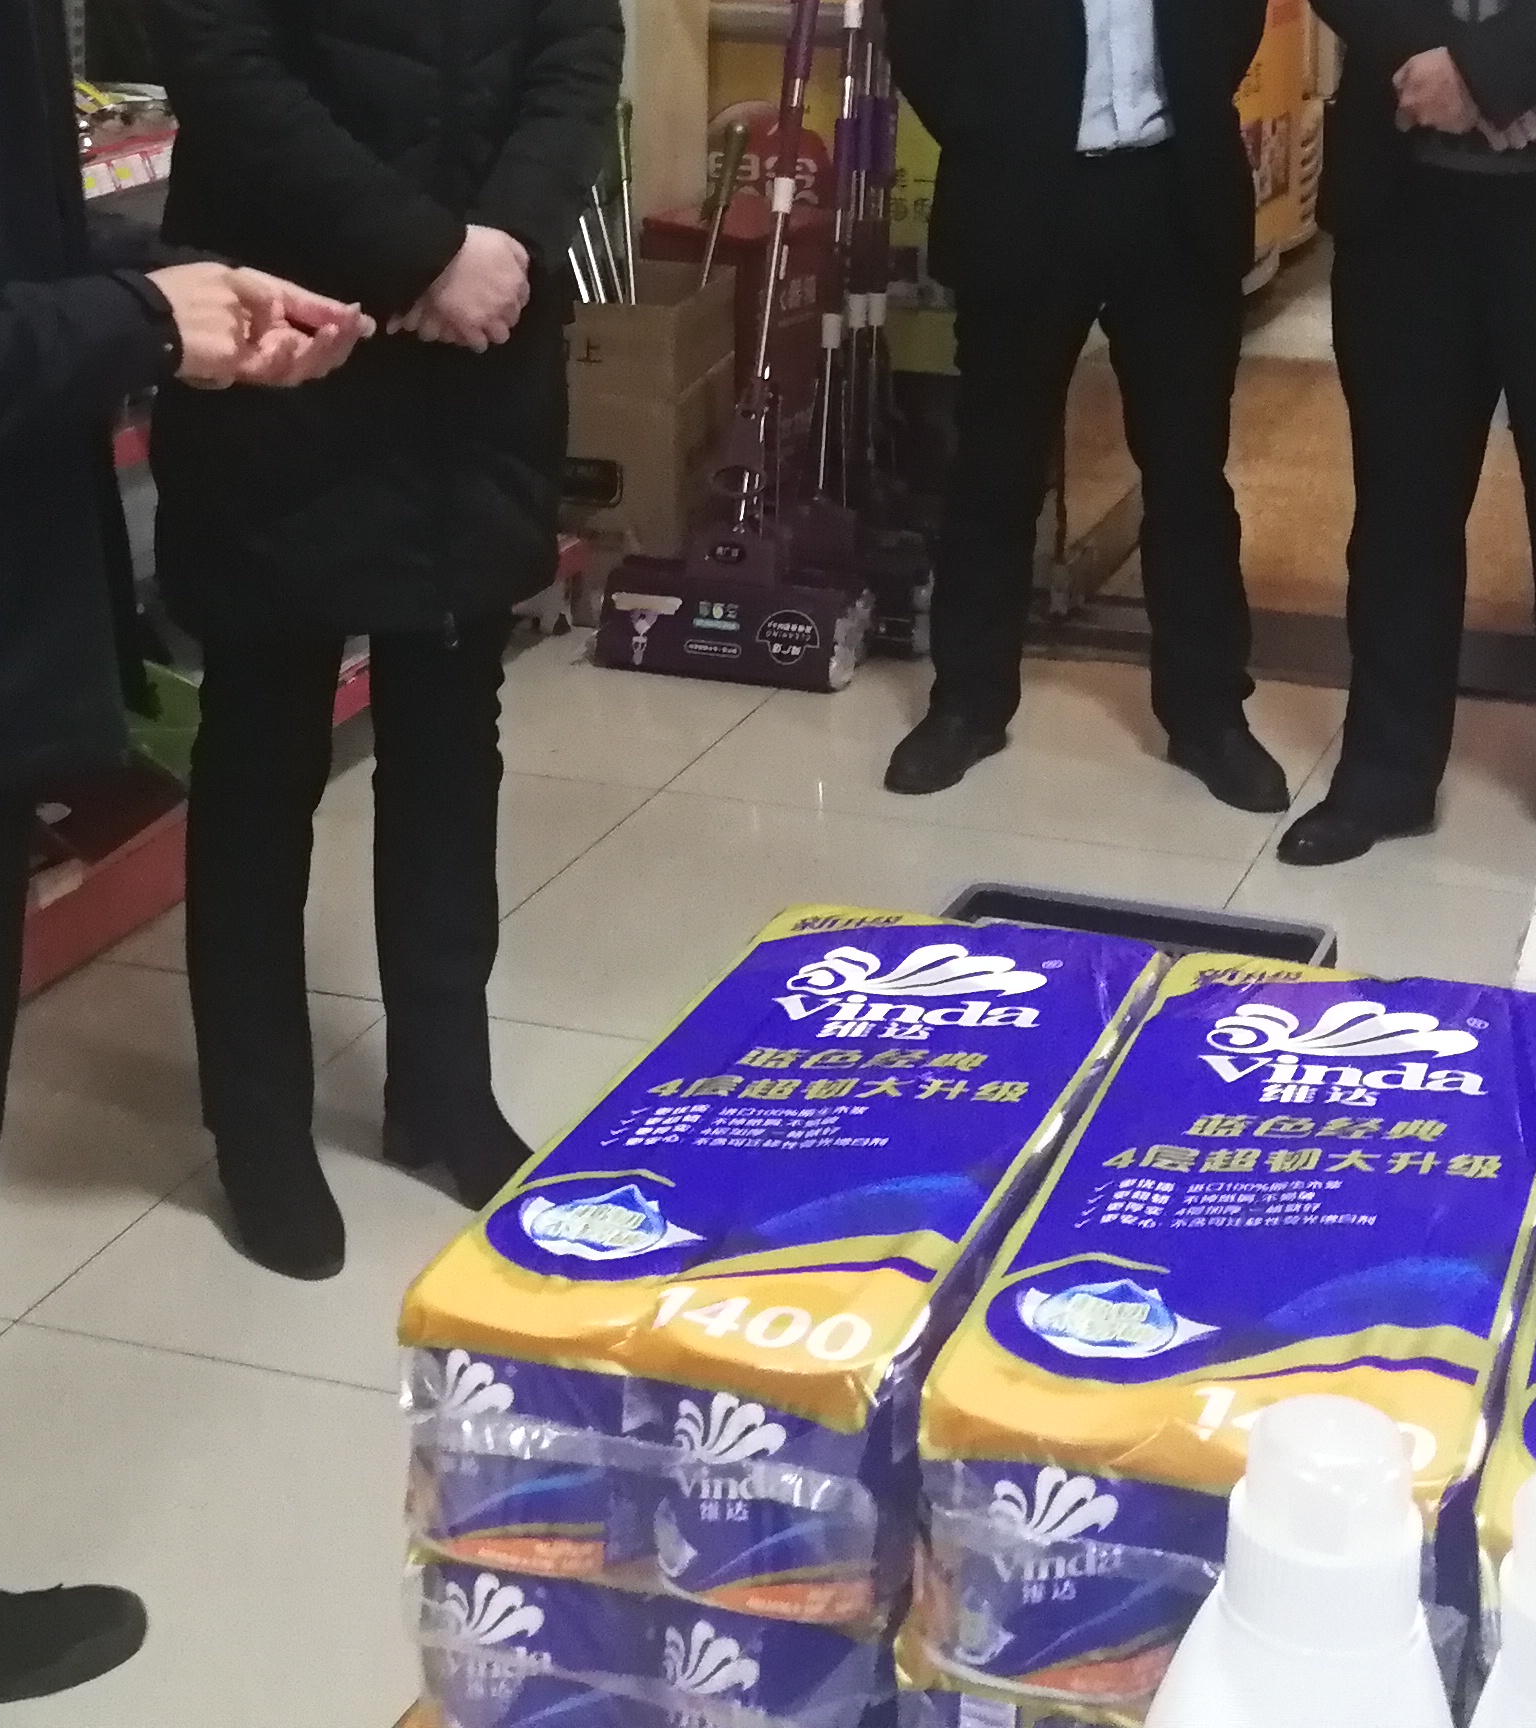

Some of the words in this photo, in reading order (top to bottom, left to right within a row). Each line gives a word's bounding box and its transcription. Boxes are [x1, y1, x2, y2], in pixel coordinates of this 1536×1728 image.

[773, 992, 1040, 1029] Vinda
[815, 1020, 934, 1041] 维达
[736, 1047, 989, 1071] 蓝色经典
[1199, 1053, 1488, 1095] Vinda
[648, 1076, 1029, 1104] 4层超韧大升级
[1259, 1083, 1378, 1106] 维达
[1187, 1114, 1448, 1141] 蓝色经典
[1102, 1144, 1503, 1179] 4层超韧大升级
[651, 1285, 872, 1363] 1400
[699, 1501, 749, 1522] 维达
